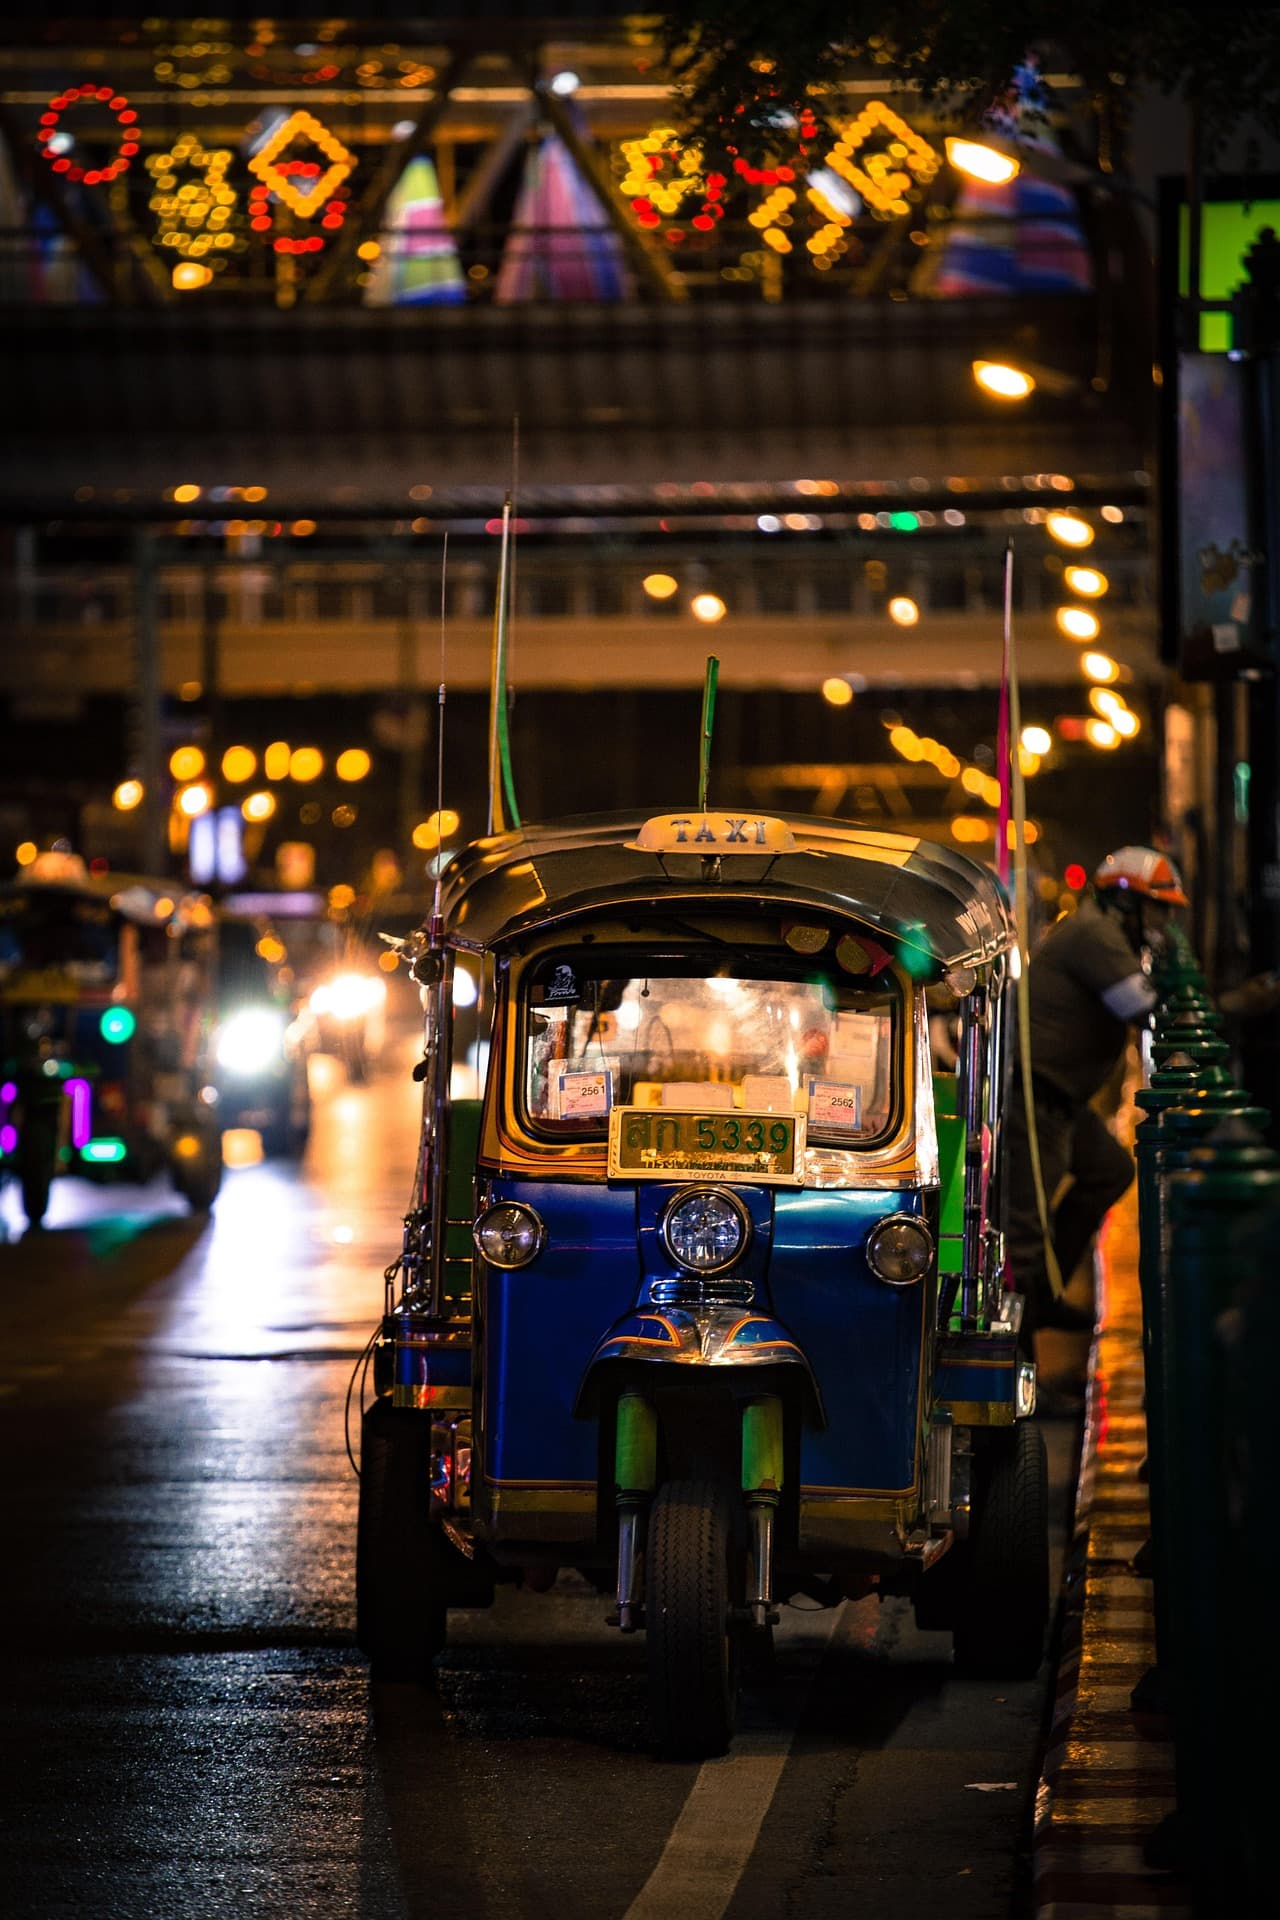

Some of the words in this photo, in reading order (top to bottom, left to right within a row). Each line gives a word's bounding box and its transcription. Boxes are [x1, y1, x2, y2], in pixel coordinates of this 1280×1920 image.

[670, 818, 767, 845] TAXI
[581, 1085, 605, 1096] 2561
[831, 1096, 854, 1109] 2562
[697, 1118, 791, 1154] 5339
[687, 1171, 727, 1180] TOYOTA
